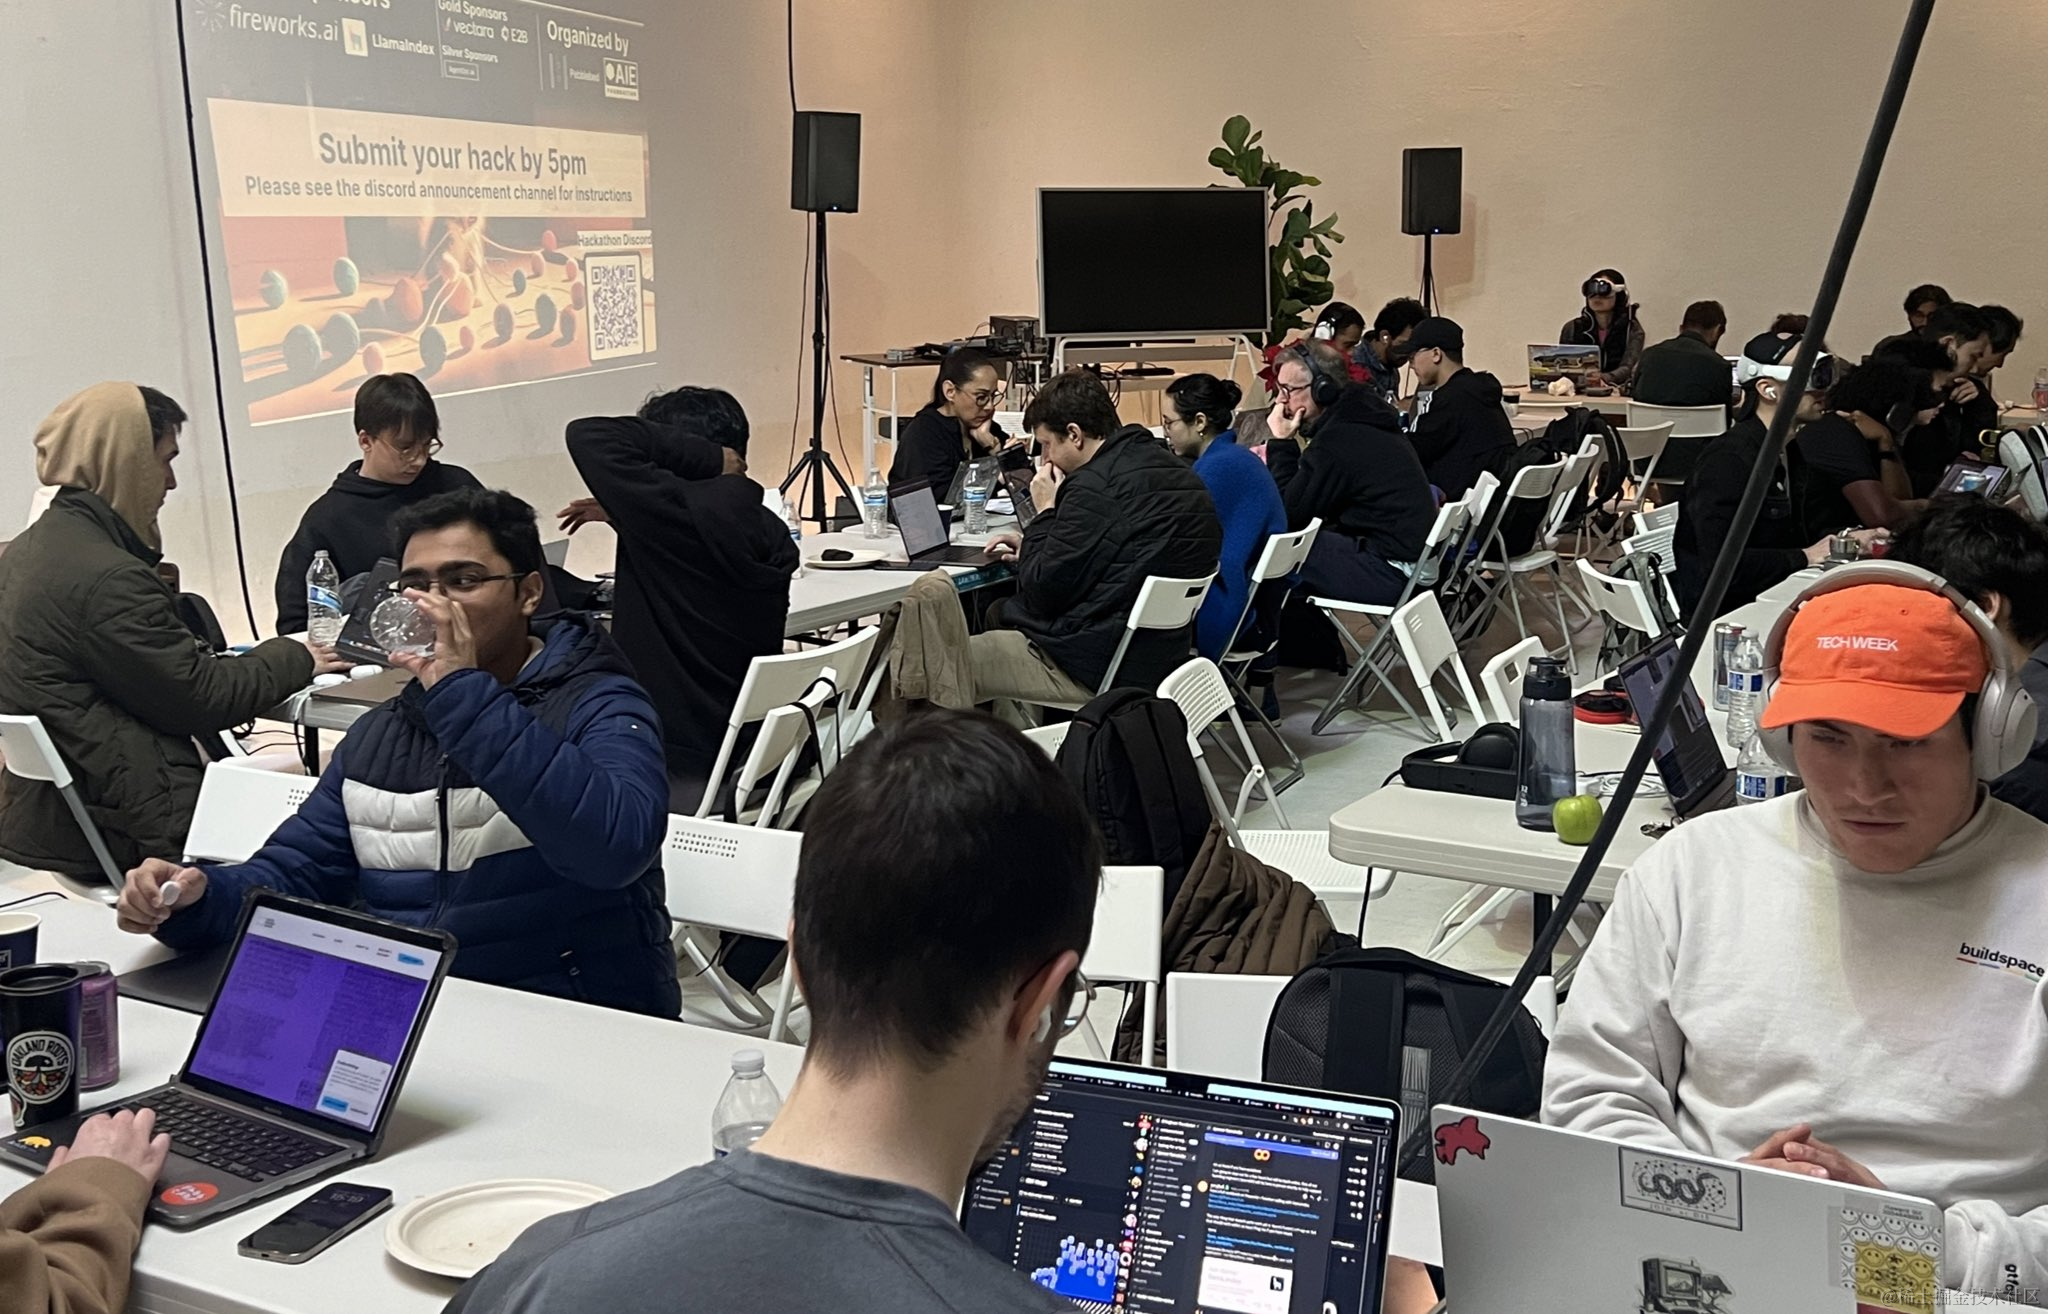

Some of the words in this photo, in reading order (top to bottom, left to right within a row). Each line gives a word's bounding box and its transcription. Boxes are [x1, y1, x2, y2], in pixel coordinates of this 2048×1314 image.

[229, 4, 338, 41] fireworks.ai
[438, 0, 462, 13] Gold
[462, 1, 508, 21] Sponsors
[453, 20, 495, 39] vectara
[511, 28, 528, 43] E2B
[547, 20, 613, 48] Organized
[614, 32, 629, 57] by
[372, 34, 435, 56] LlamaIndex
[615, 64, 637, 86] AIE
[318, 132, 407, 167] Submit
[412, 144, 462, 175] your
[467, 142, 516, 172] hack
[520, 146, 543, 179] by
[548, 148, 587, 180] 5pm
[245, 176, 301, 195] Please
[305, 181, 333, 196] see
[336, 178, 360, 196] the
[364, 179, 416, 198] discord
[419, 184, 511, 200] announcement
[514, 186, 557, 201] channel
[559, 185, 574, 201] for
[575, 186, 632, 202] instructions
[578, 233, 621, 247] Hackathon
[1816, 636, 1851, 649] TECH
[1852, 636, 1899, 652] WEEK
[1960, 942, 2046, 977] buildspace
[12, 1039, 46, 1067] OAKLAND
[45, 1040, 69, 1067] ROOTS
